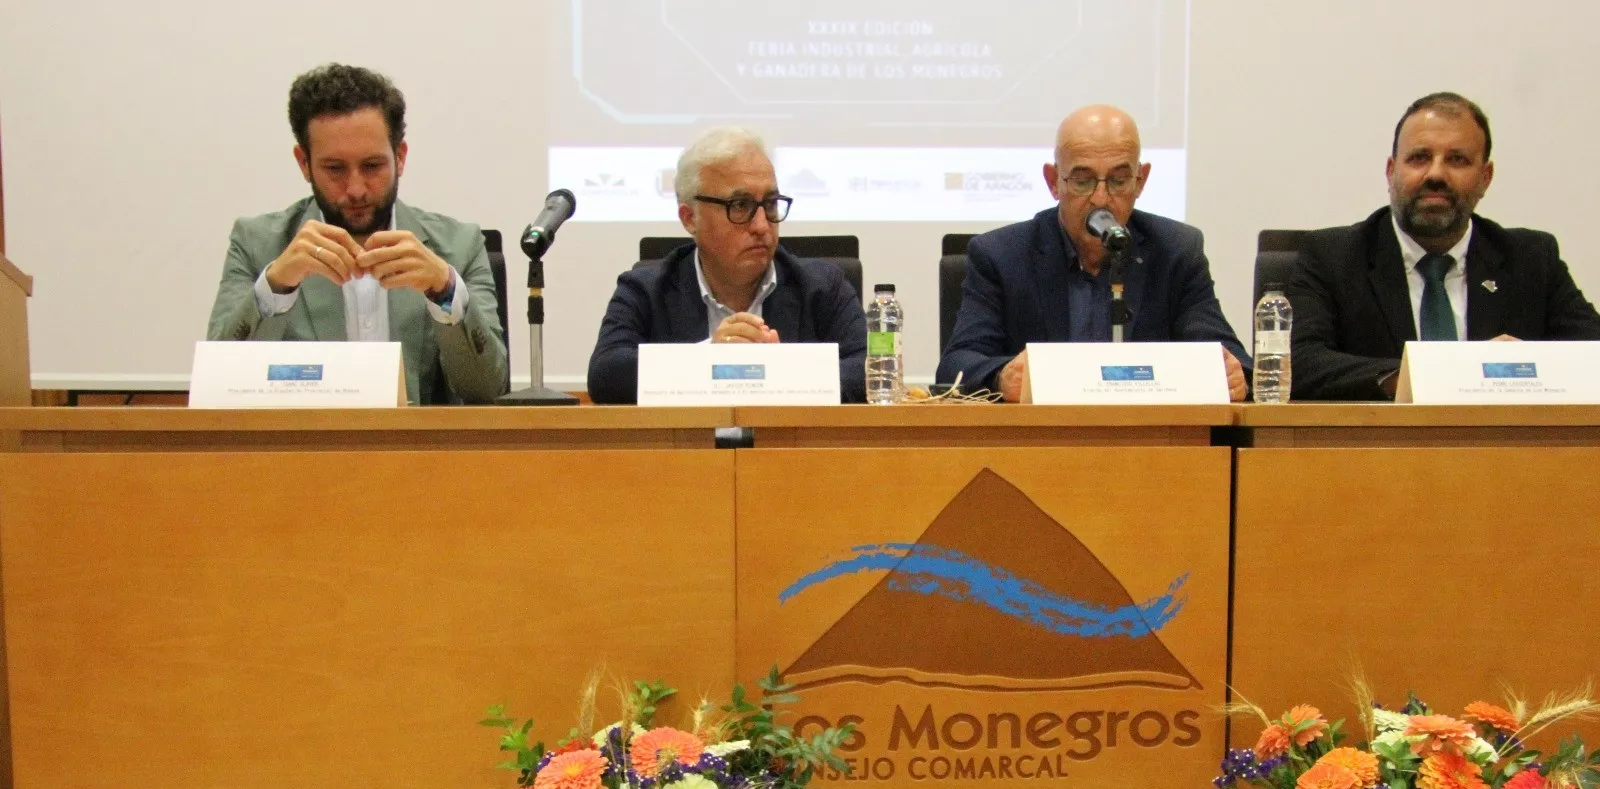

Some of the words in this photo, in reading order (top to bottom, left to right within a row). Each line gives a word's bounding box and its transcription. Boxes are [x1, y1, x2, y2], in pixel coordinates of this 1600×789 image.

[748, 40, 797, 57] FERIA
[736, 63, 746, 76] Y
[752, 62, 841, 78] GANADERA
[846, 62, 866, 78] DE
[874, 62, 906, 78] LOS
[911, 63, 1004, 79] MONEGROS
[887, 703, 1201, 761] Monegros
[907, 755, 1069, 780] COMARCAL
